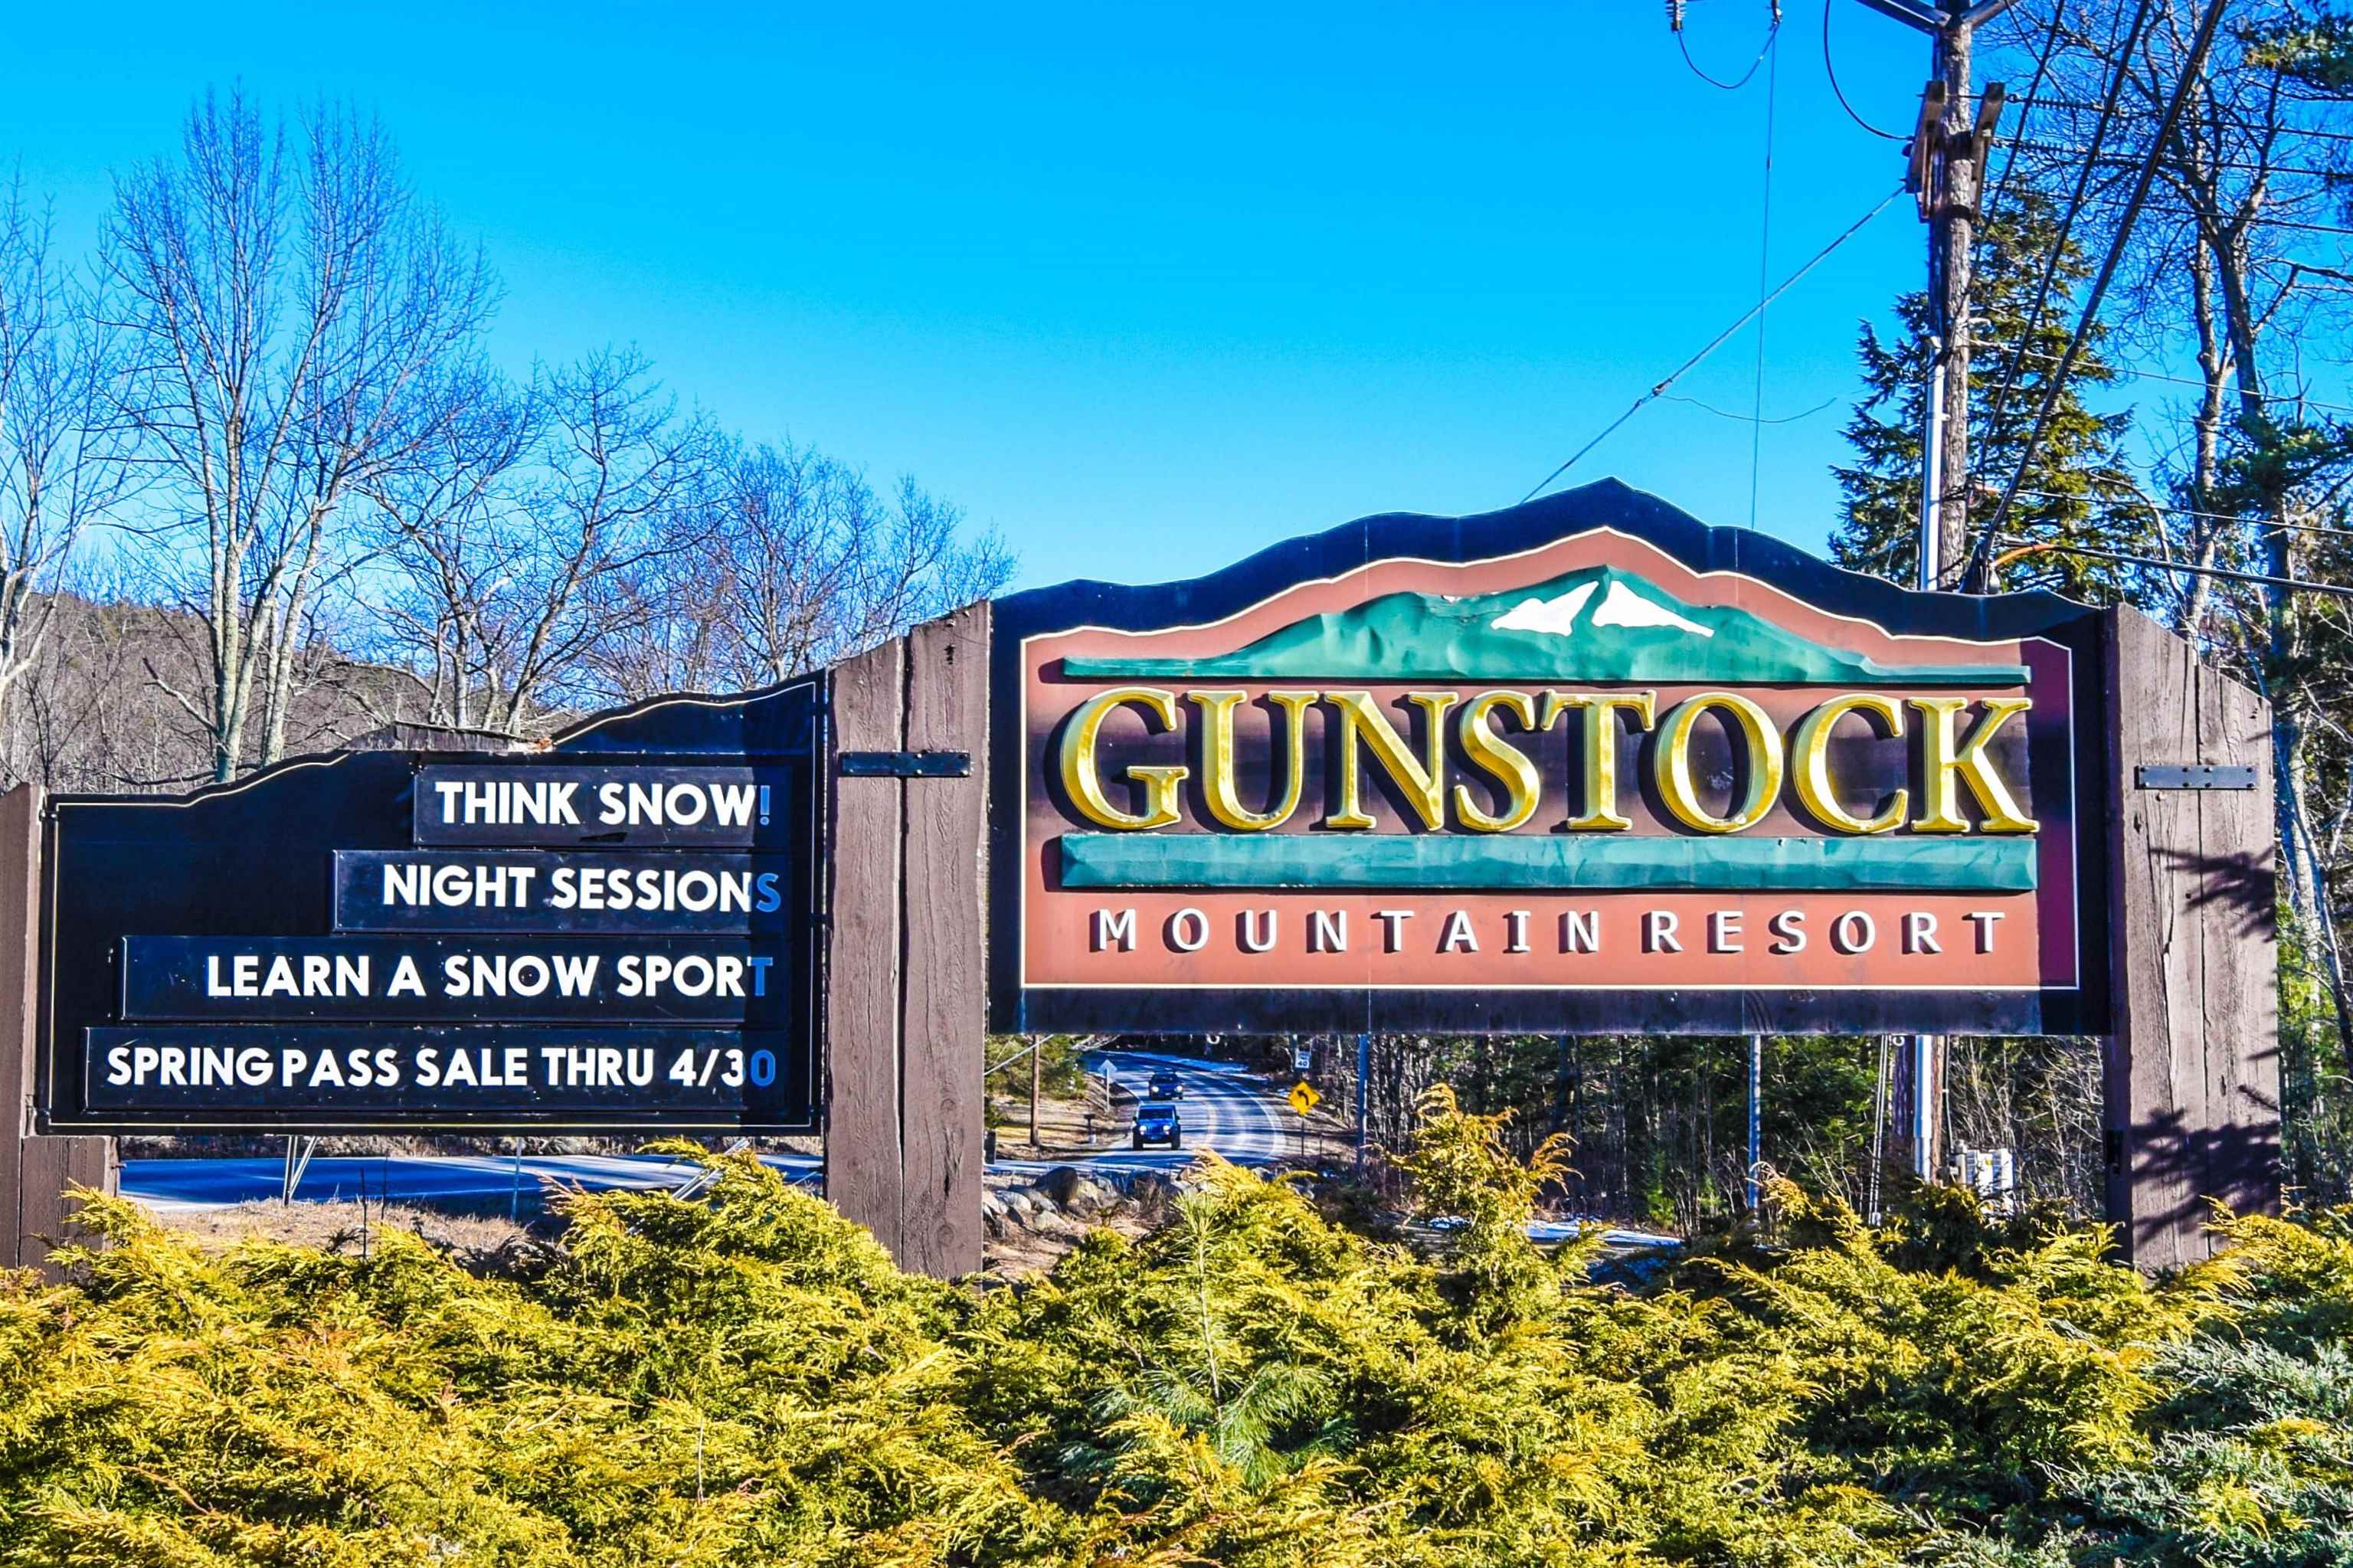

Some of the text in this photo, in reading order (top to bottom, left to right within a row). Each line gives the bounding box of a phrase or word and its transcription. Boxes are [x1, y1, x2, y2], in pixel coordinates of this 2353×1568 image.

[1061, 686, 2040, 833] GUNSTOCK
[434, 781, 771, 827] THINK SNOW!
[382, 864, 781, 913] NIGHT SESSIONS
[1098, 907, 2007, 954] MOUNTAIN RESORT
[207, 954, 774, 997] LEARN A SNOW SPORT
[106, 1046, 777, 1088] SPRING PASS SALE THRU 4/30
